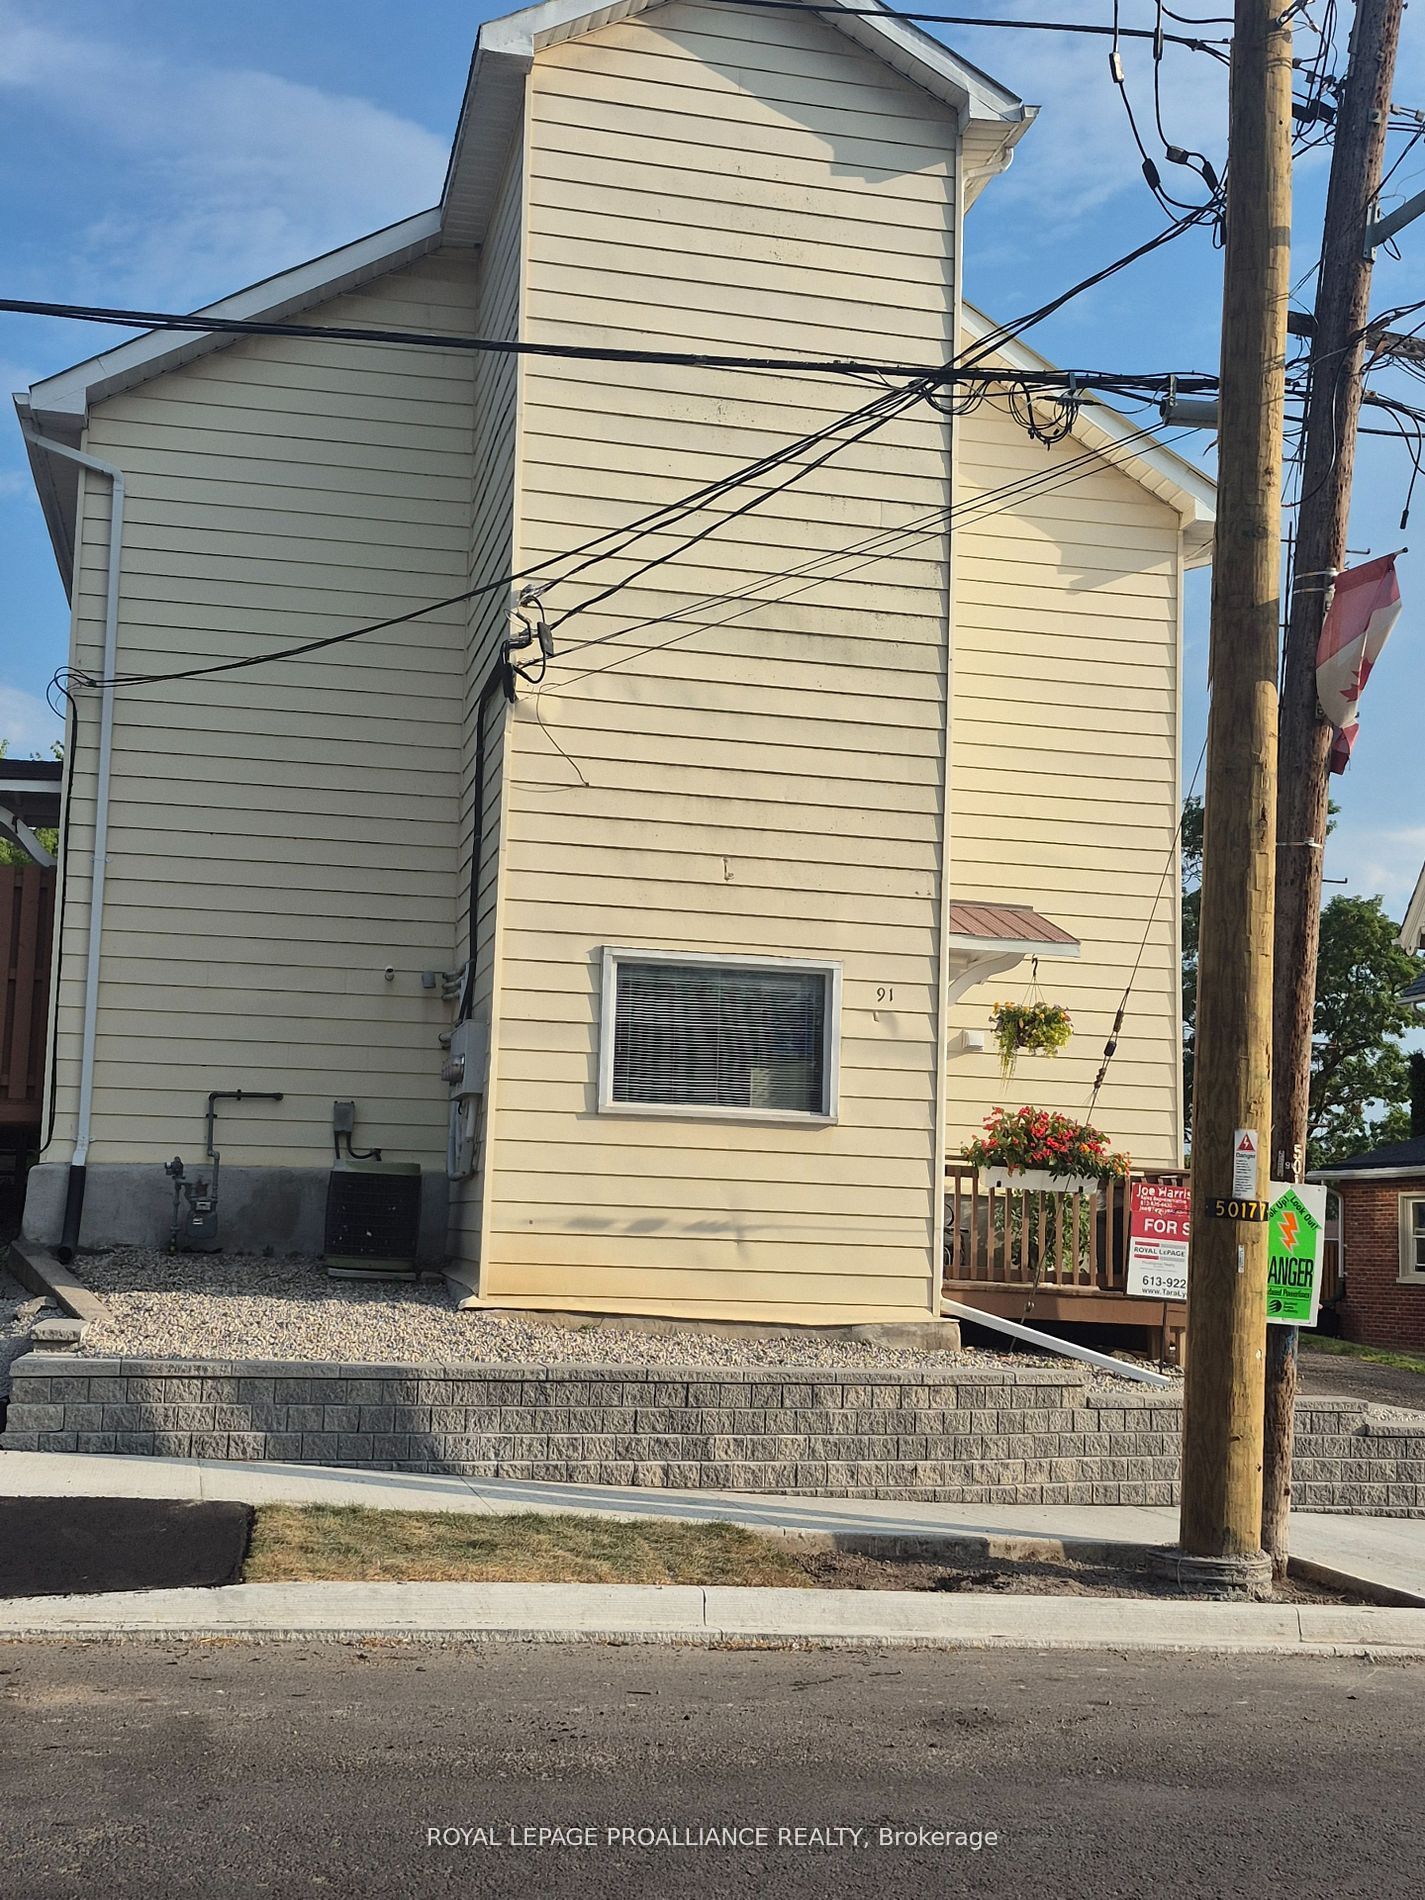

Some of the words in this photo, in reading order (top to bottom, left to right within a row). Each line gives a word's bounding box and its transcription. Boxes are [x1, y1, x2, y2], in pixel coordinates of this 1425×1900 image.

[876, 987, 893, 1002] 91
[1235, 1152, 1256, 1160] Danger
[1136, 1184, 1156, 1198] Joe
[1275, 1195, 1290, 1209] Up!
[1216, 1200, 1267, 1221] 50177
[1290, 1196, 1306, 1216] Look
[1303, 1213, 1319, 1231] Out!
[1144, 1218, 1178, 1235] FOR
[1133, 1246, 1158, 1255] ROYAL
[1142, 1274, 1187, 1289] 613-922
